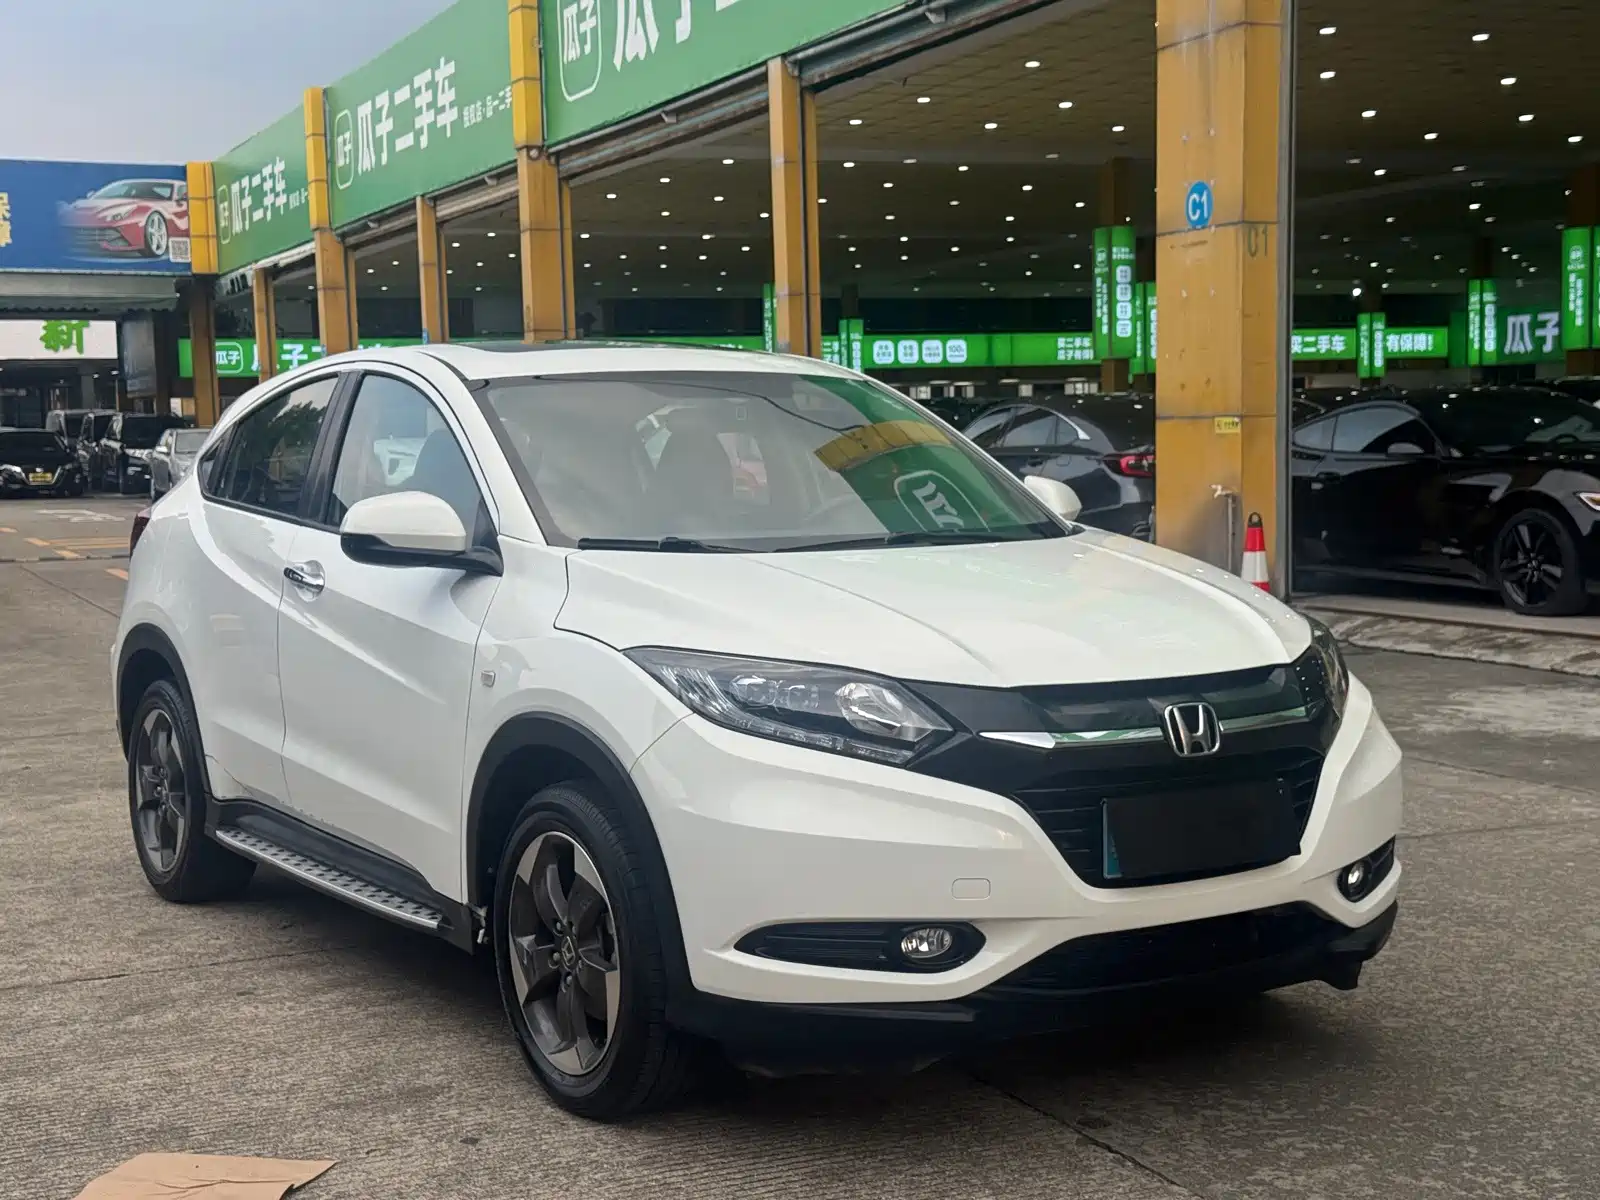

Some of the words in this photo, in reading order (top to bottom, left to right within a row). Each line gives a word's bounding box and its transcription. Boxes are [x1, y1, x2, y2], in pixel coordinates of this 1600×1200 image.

[563, 0, 597, 64] 瓜子
[357, 56, 458, 176] 瓜子二手车
[230, 156, 287, 236] 瓜子二手车
[1188, 189, 1208, 221] C1
[215, 350, 241, 366] 瓜子
[1504, 311, 1559, 355] 瓜子
